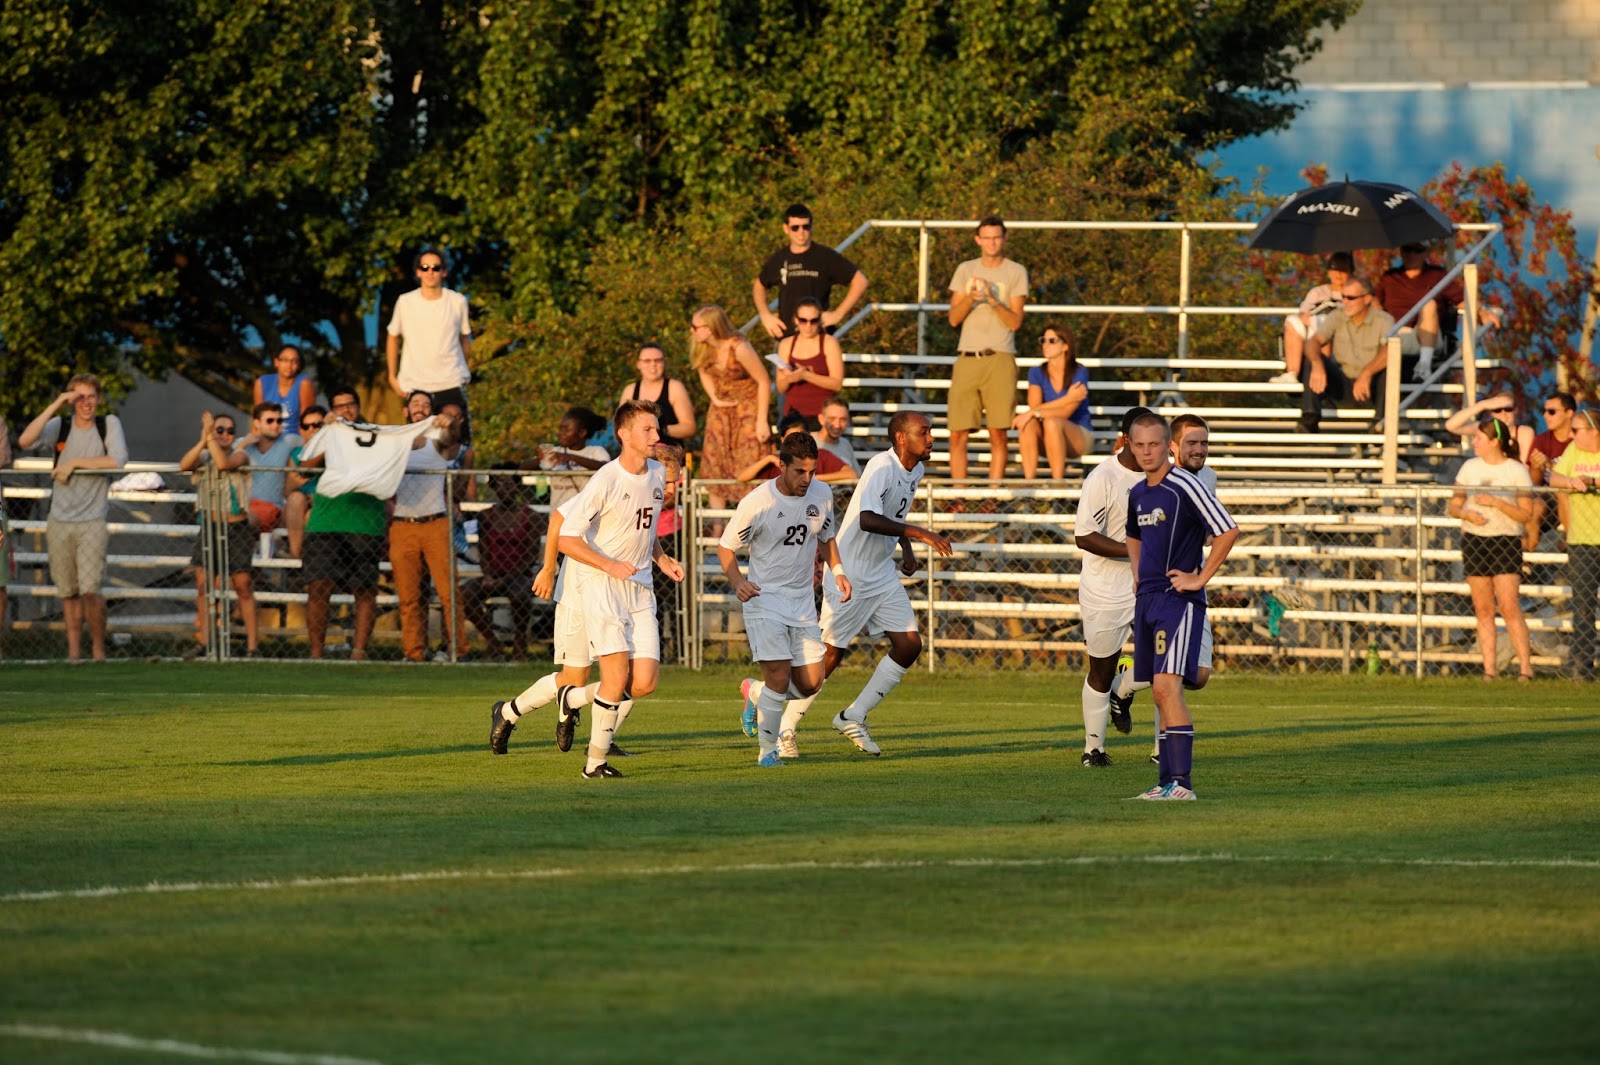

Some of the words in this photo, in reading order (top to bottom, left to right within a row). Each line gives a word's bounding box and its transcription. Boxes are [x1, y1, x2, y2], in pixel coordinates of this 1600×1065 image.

[1297, 202, 1360, 217] MAXFLI
[636, 506, 653, 530] 15
[895, 498, 907, 519] 2
[783, 524, 808, 546] 23
[1155, 629, 1166, 655] 6
